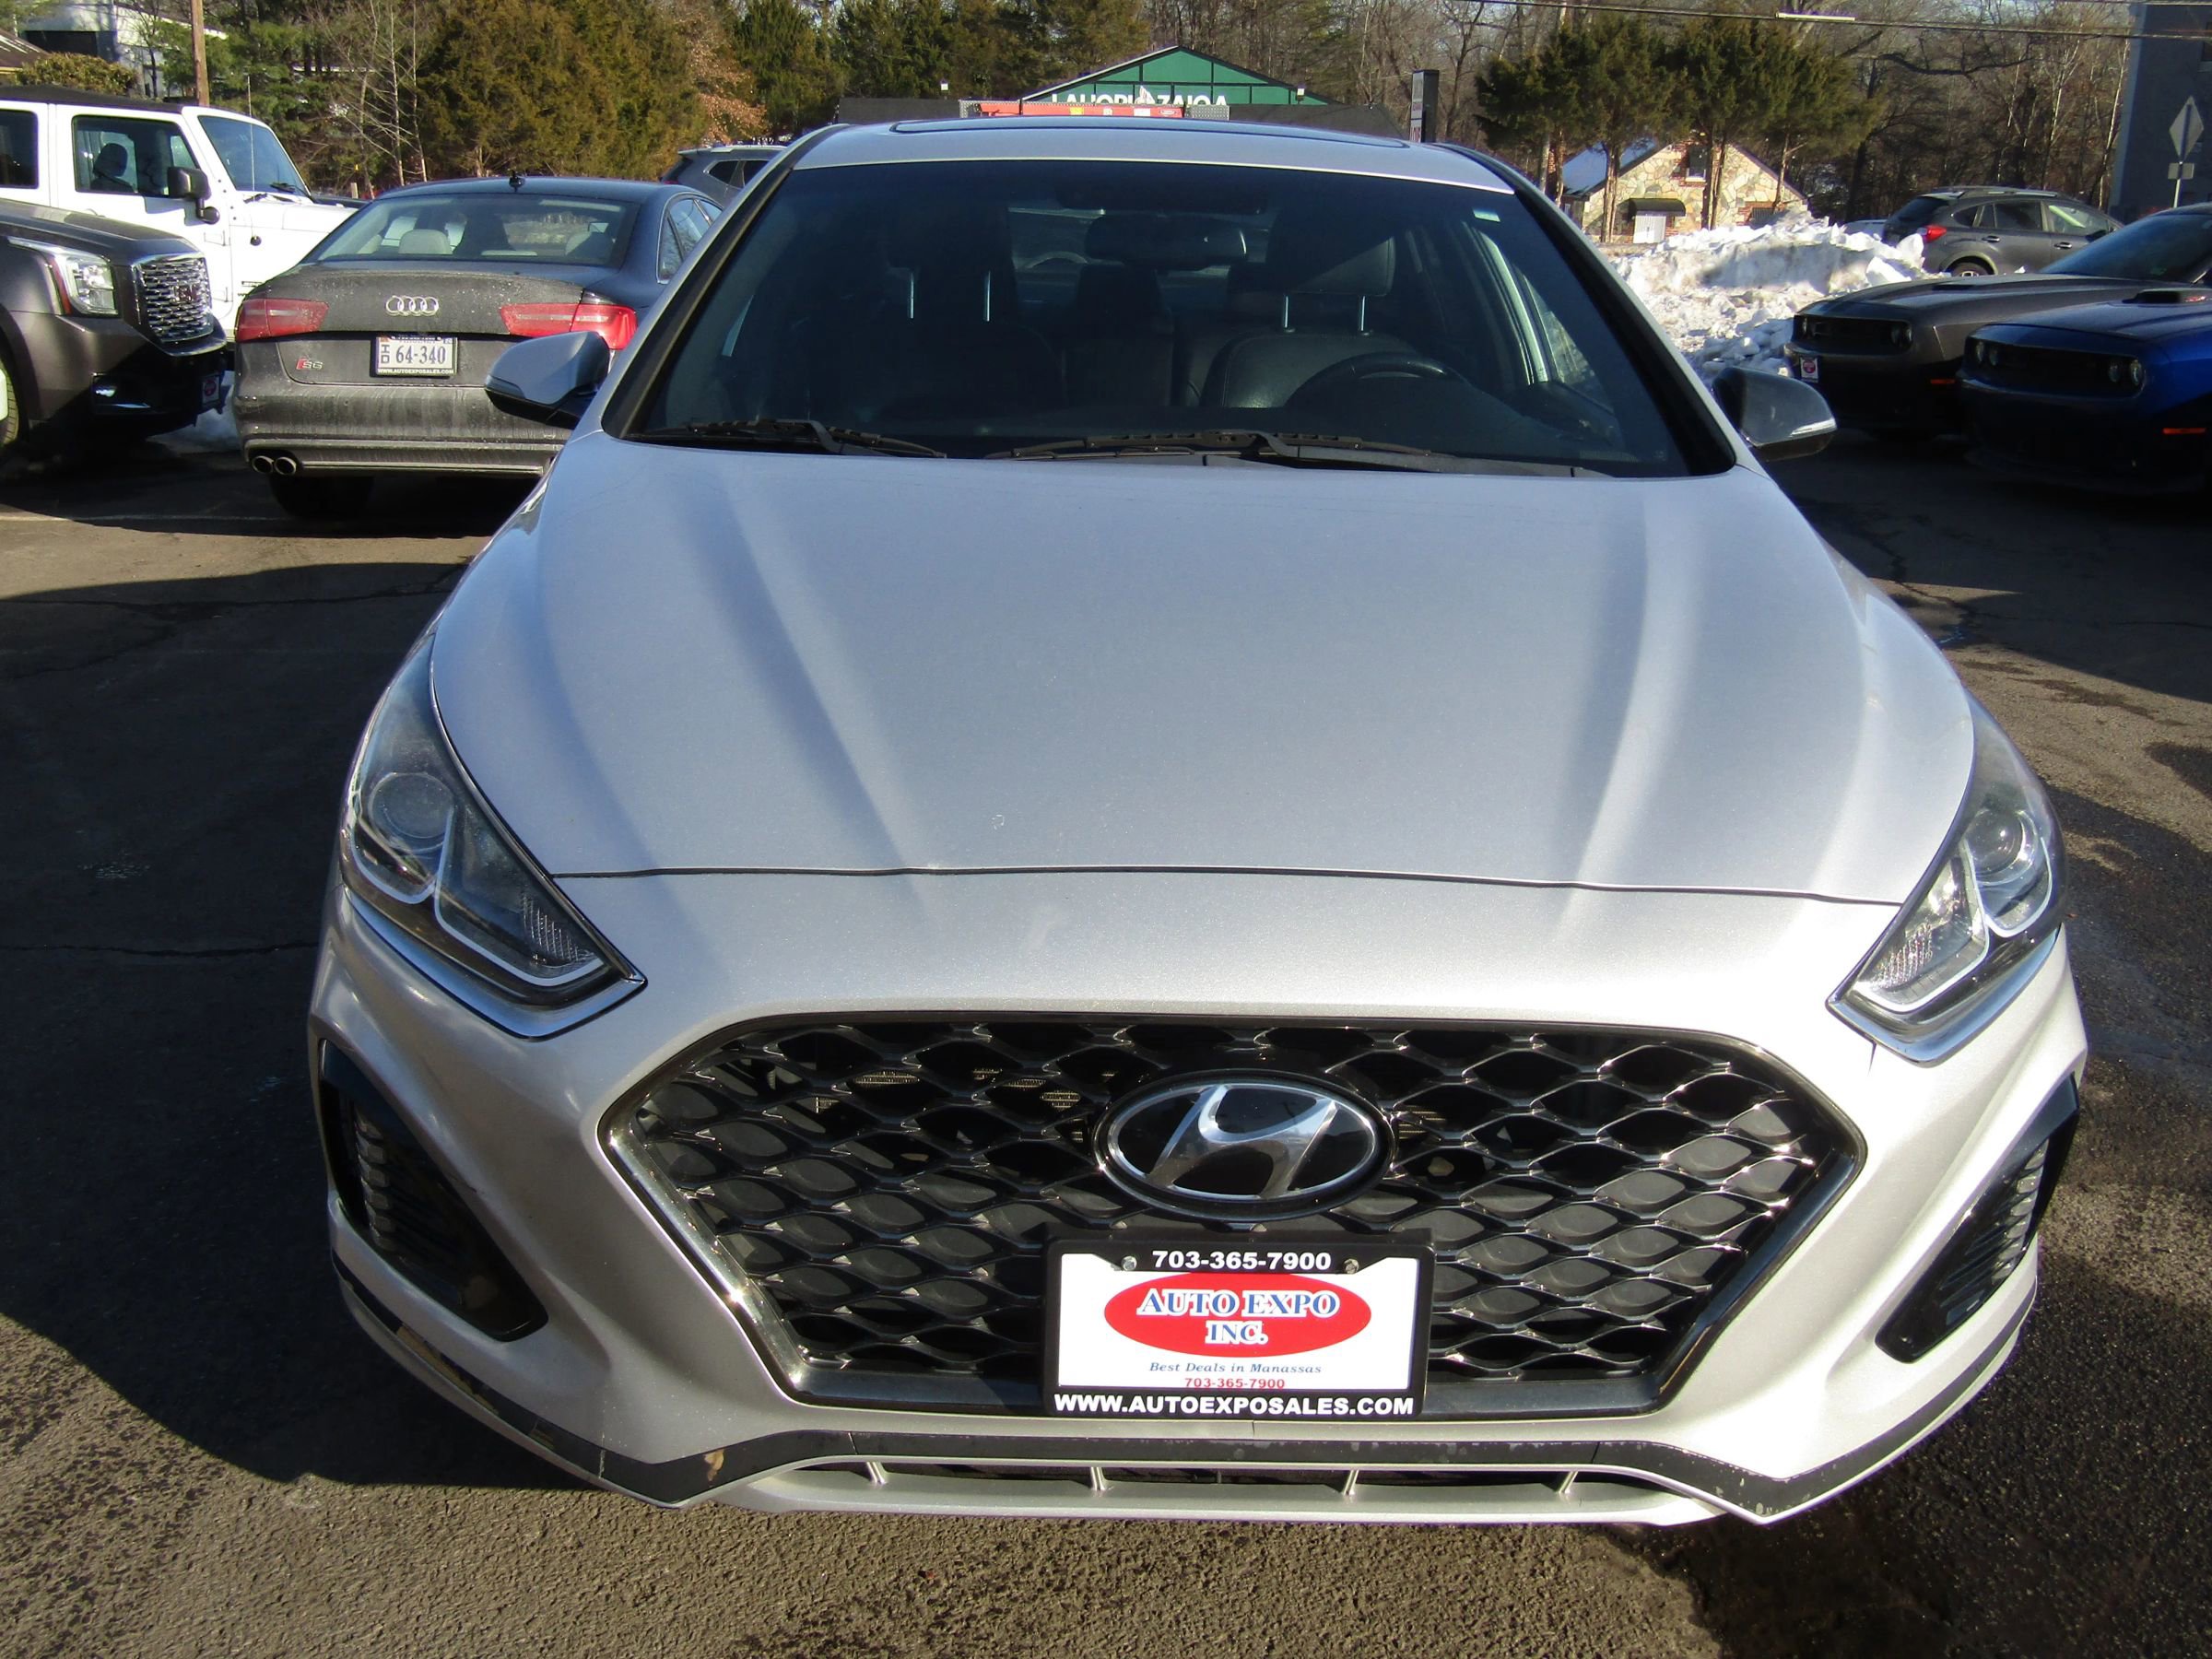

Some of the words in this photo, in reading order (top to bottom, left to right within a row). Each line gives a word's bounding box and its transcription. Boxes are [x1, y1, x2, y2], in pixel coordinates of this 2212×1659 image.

[395, 345, 446, 364] 64-340
[1152, 1251, 1332, 1270] 703-365-7900
[1138, 1288, 1240, 1317] AUTO
[1242, 1290, 1340, 1318] EXPO
[1206, 1321, 1268, 1345] INC.
[1149, 1362, 1181, 1372] Best
[1185, 1362, 1226, 1372] Deals
[1230, 1362, 1244, 1372] in
[1250, 1363, 1322, 1373] Manassas
[1184, 1377, 1285, 1389] 703-365-7900
[1054, 1394, 1414, 1416] WWW.AUTOEXPOSALES.COM
